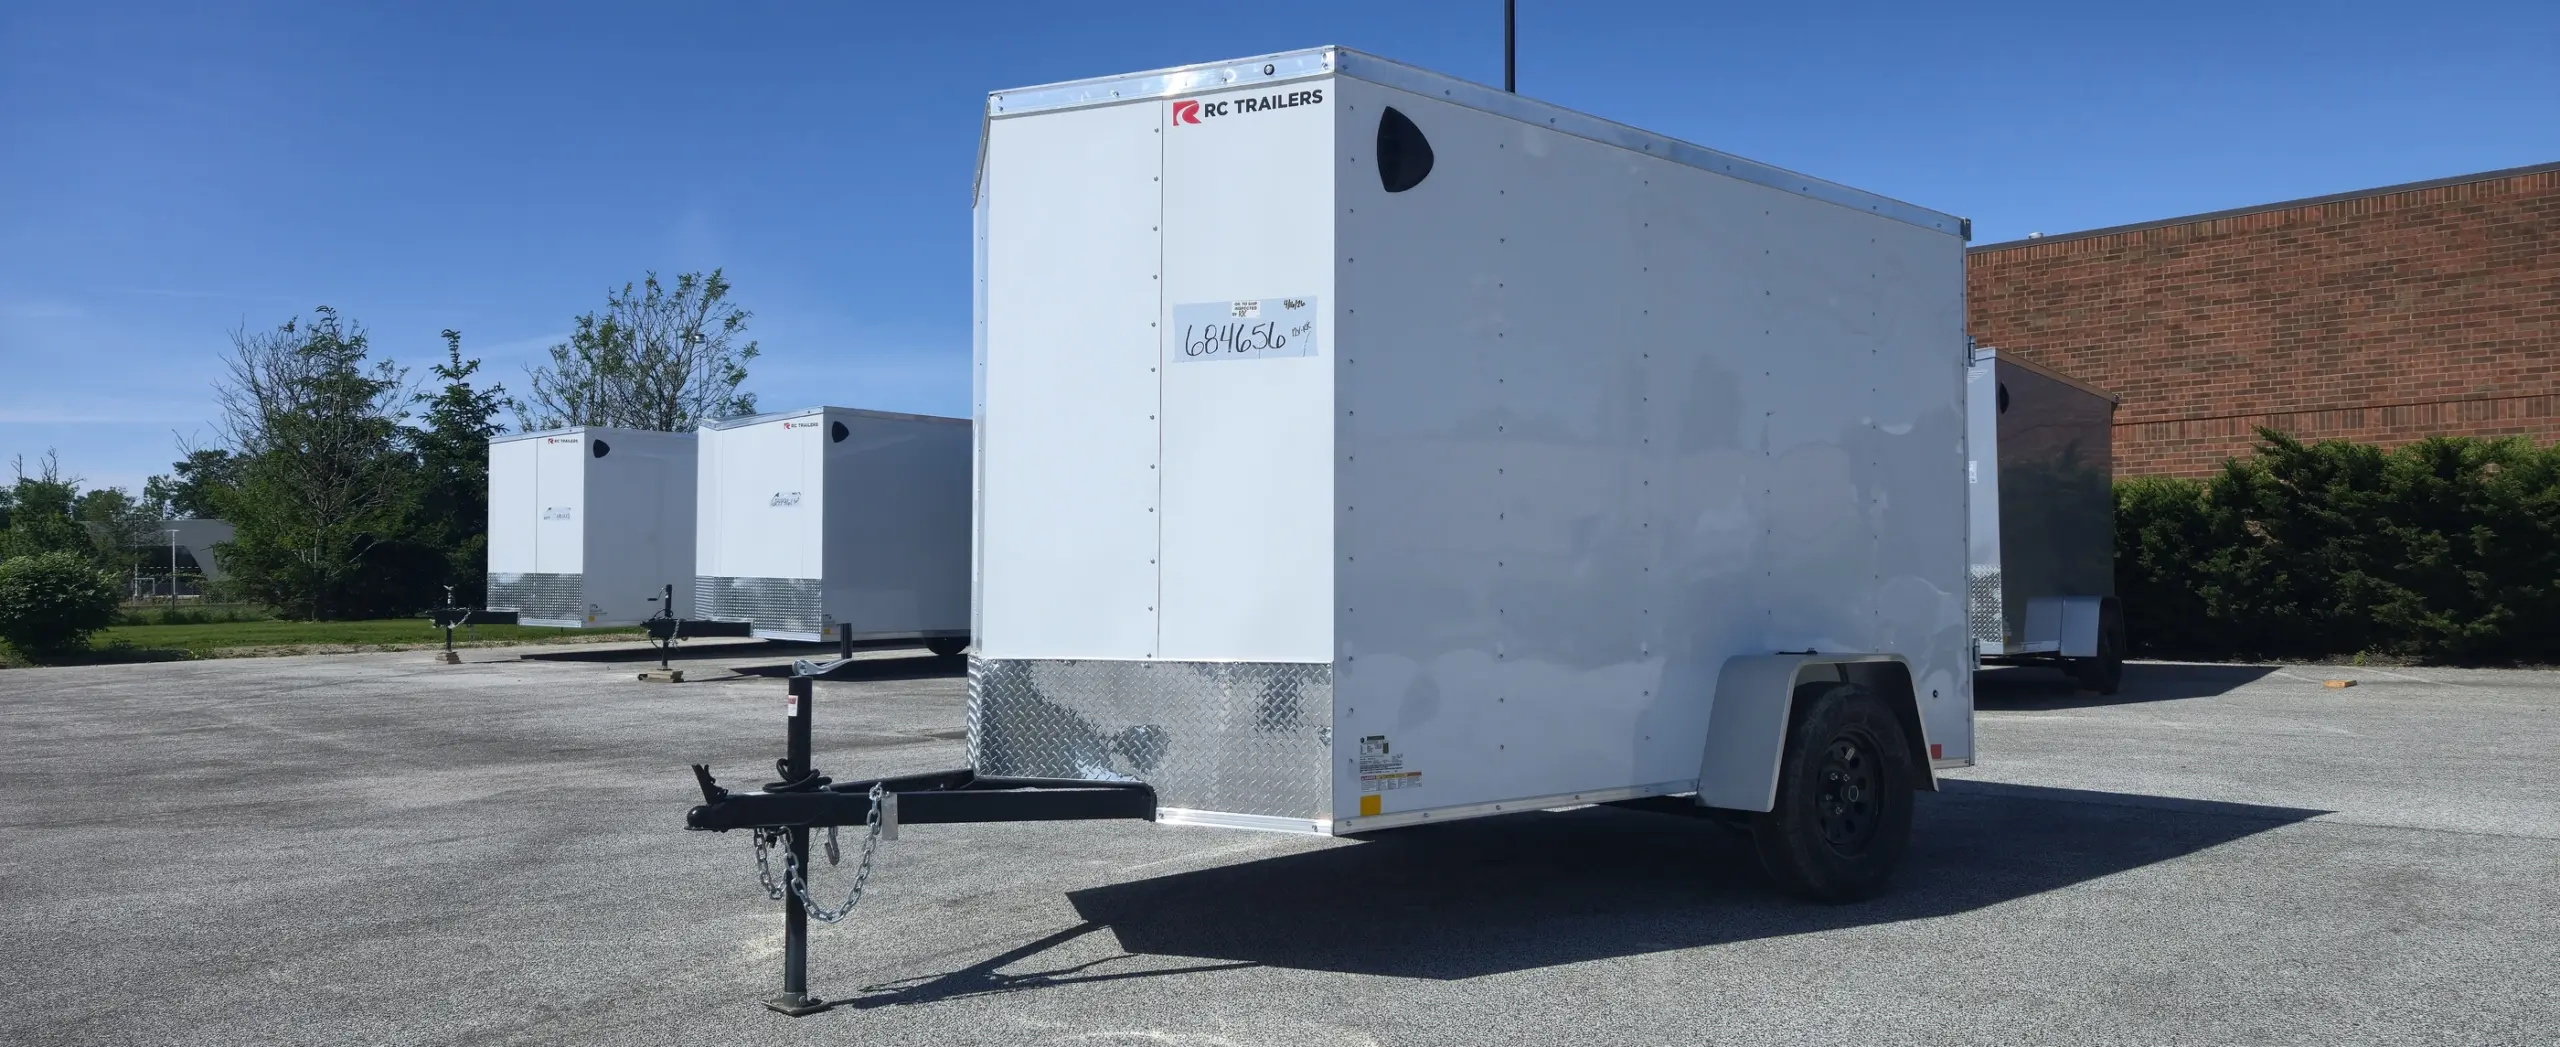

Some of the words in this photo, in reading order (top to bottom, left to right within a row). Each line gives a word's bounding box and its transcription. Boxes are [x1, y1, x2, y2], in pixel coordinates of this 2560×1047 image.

[1204, 101, 1228, 118] RC
[1234, 89, 1323, 114] TRAILERS
[1185, 321, 1286, 357] 684656
